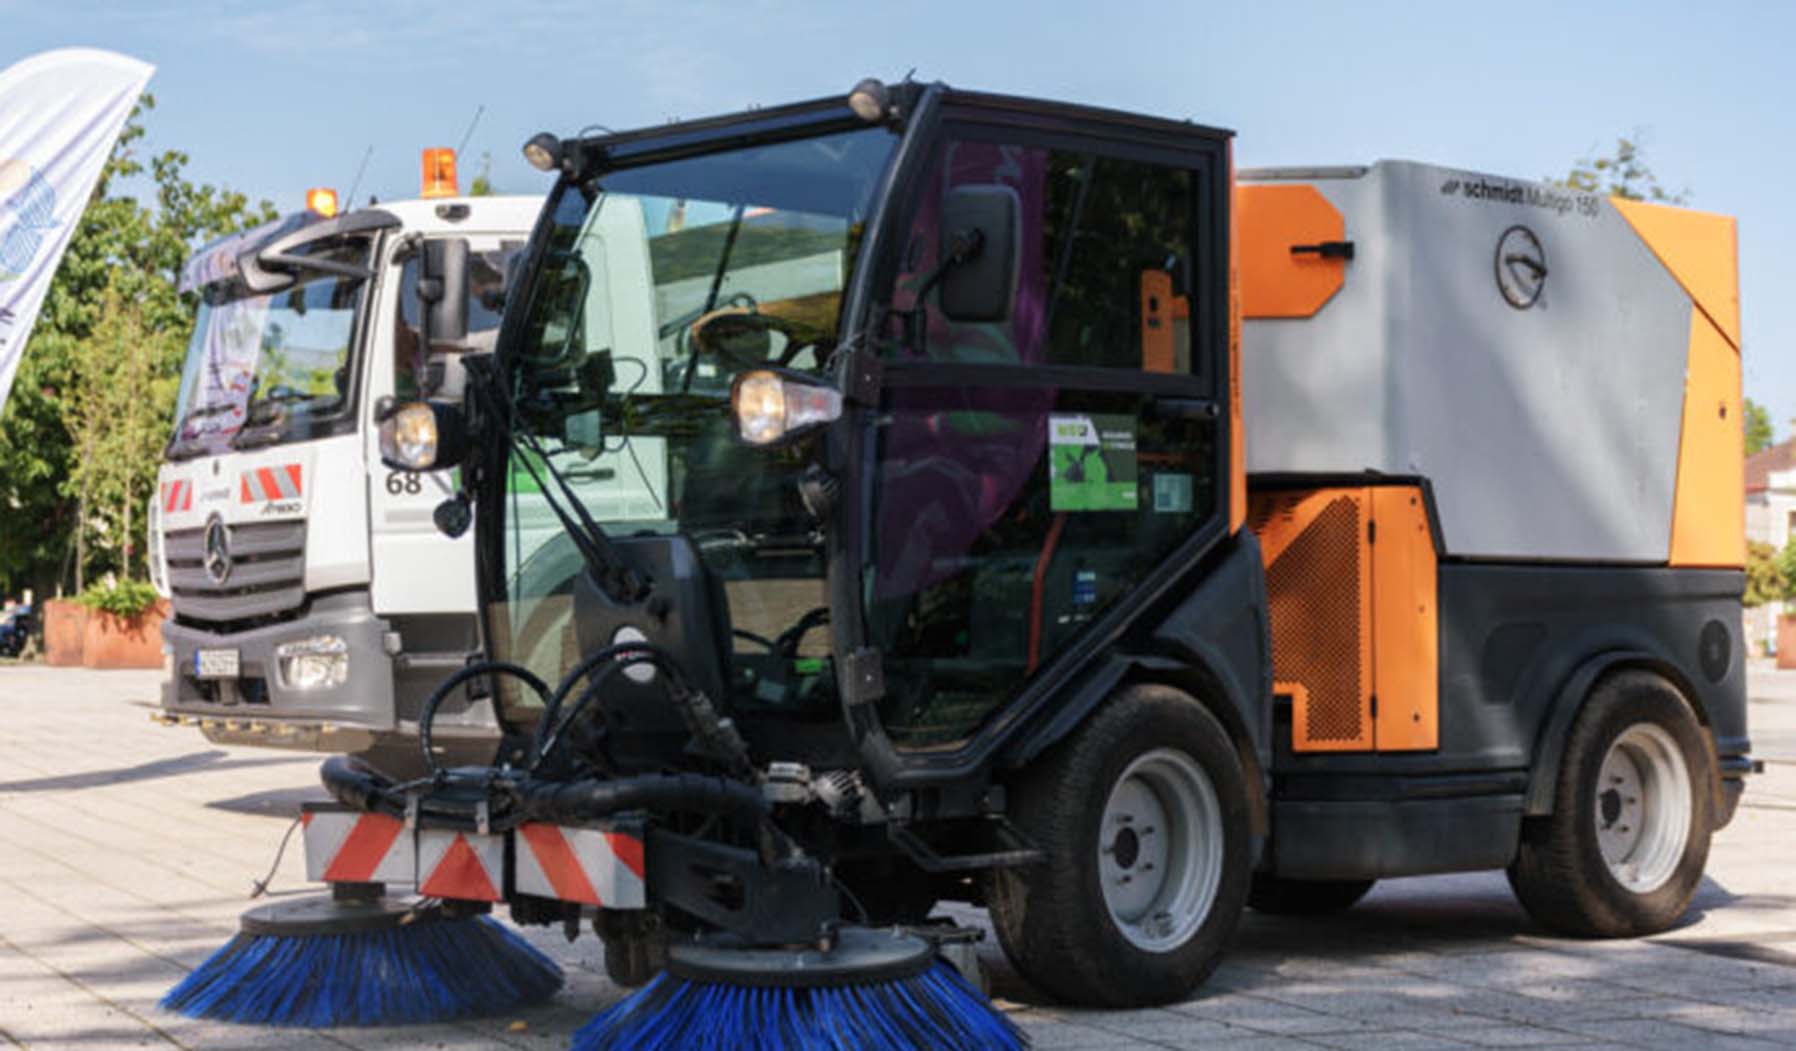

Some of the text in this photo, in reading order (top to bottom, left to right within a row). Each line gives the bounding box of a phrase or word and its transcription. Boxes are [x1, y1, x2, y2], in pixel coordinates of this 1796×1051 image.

[1463, 178, 1599, 217] schmidt Multigo 150
[385, 468, 422, 495] 68
